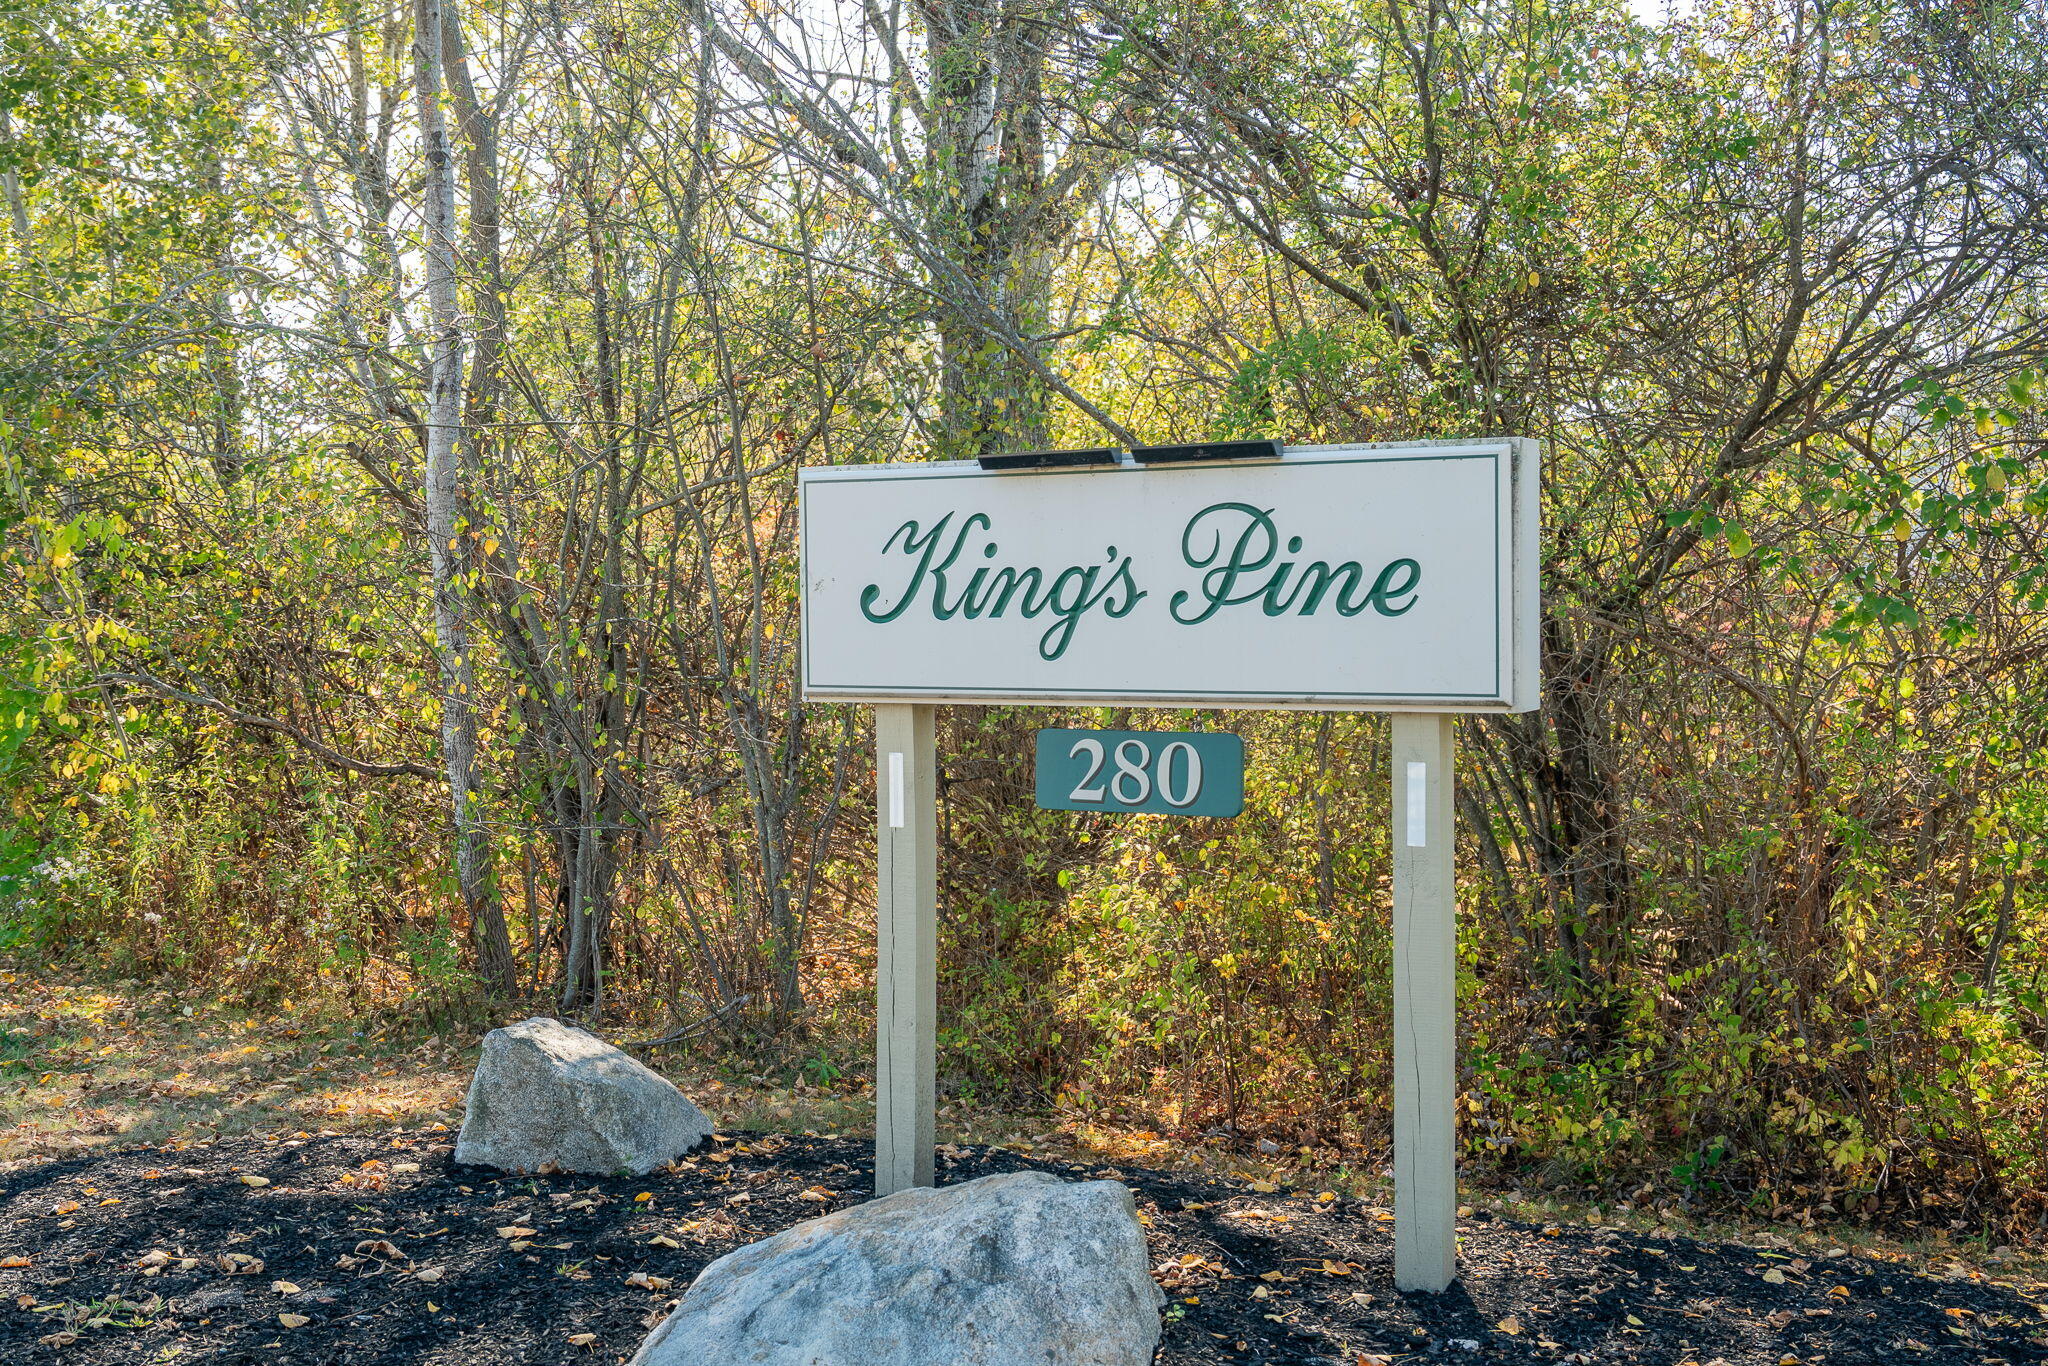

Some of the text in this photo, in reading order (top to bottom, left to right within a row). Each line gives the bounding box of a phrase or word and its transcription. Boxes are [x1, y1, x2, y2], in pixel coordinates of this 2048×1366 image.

[860, 502, 1421, 661] King's Pine
[1068, 738, 1203, 807] 280
